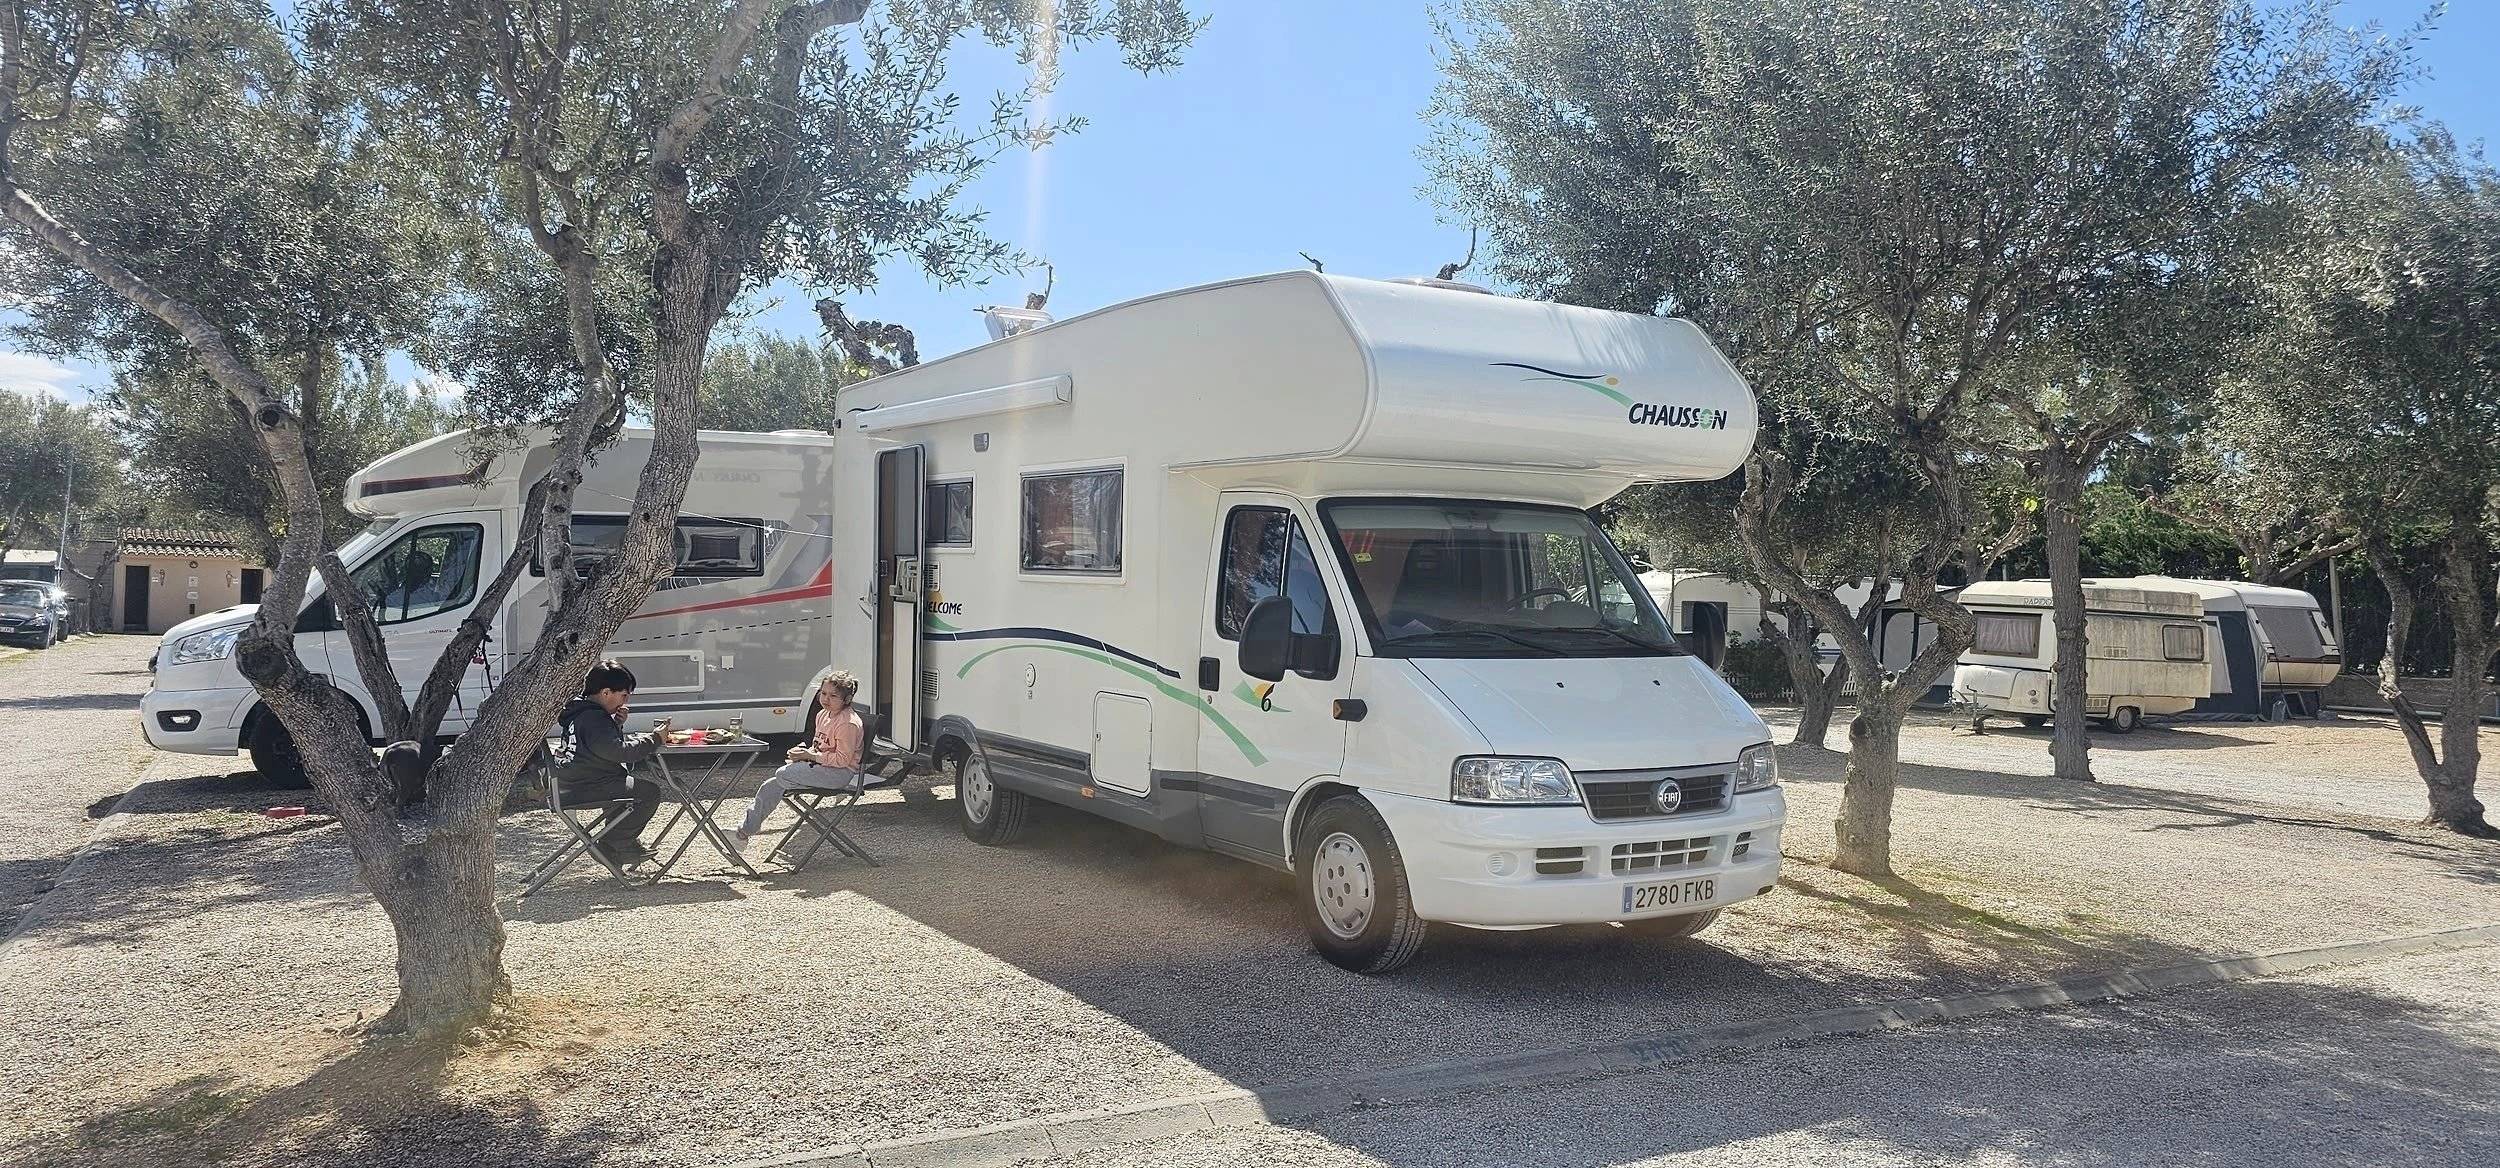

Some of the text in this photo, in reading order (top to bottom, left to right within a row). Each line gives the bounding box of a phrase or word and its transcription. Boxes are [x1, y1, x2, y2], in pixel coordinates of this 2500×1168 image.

[1628, 403, 1728, 430] CHAUSSON
[928, 600, 963, 615] ELCOME
[1261, 683, 1275, 712] 6
[1664, 791, 1678, 803] FIAT
[1635, 884, 1679, 908] 2780
[1684, 880, 1714, 902] FKB
